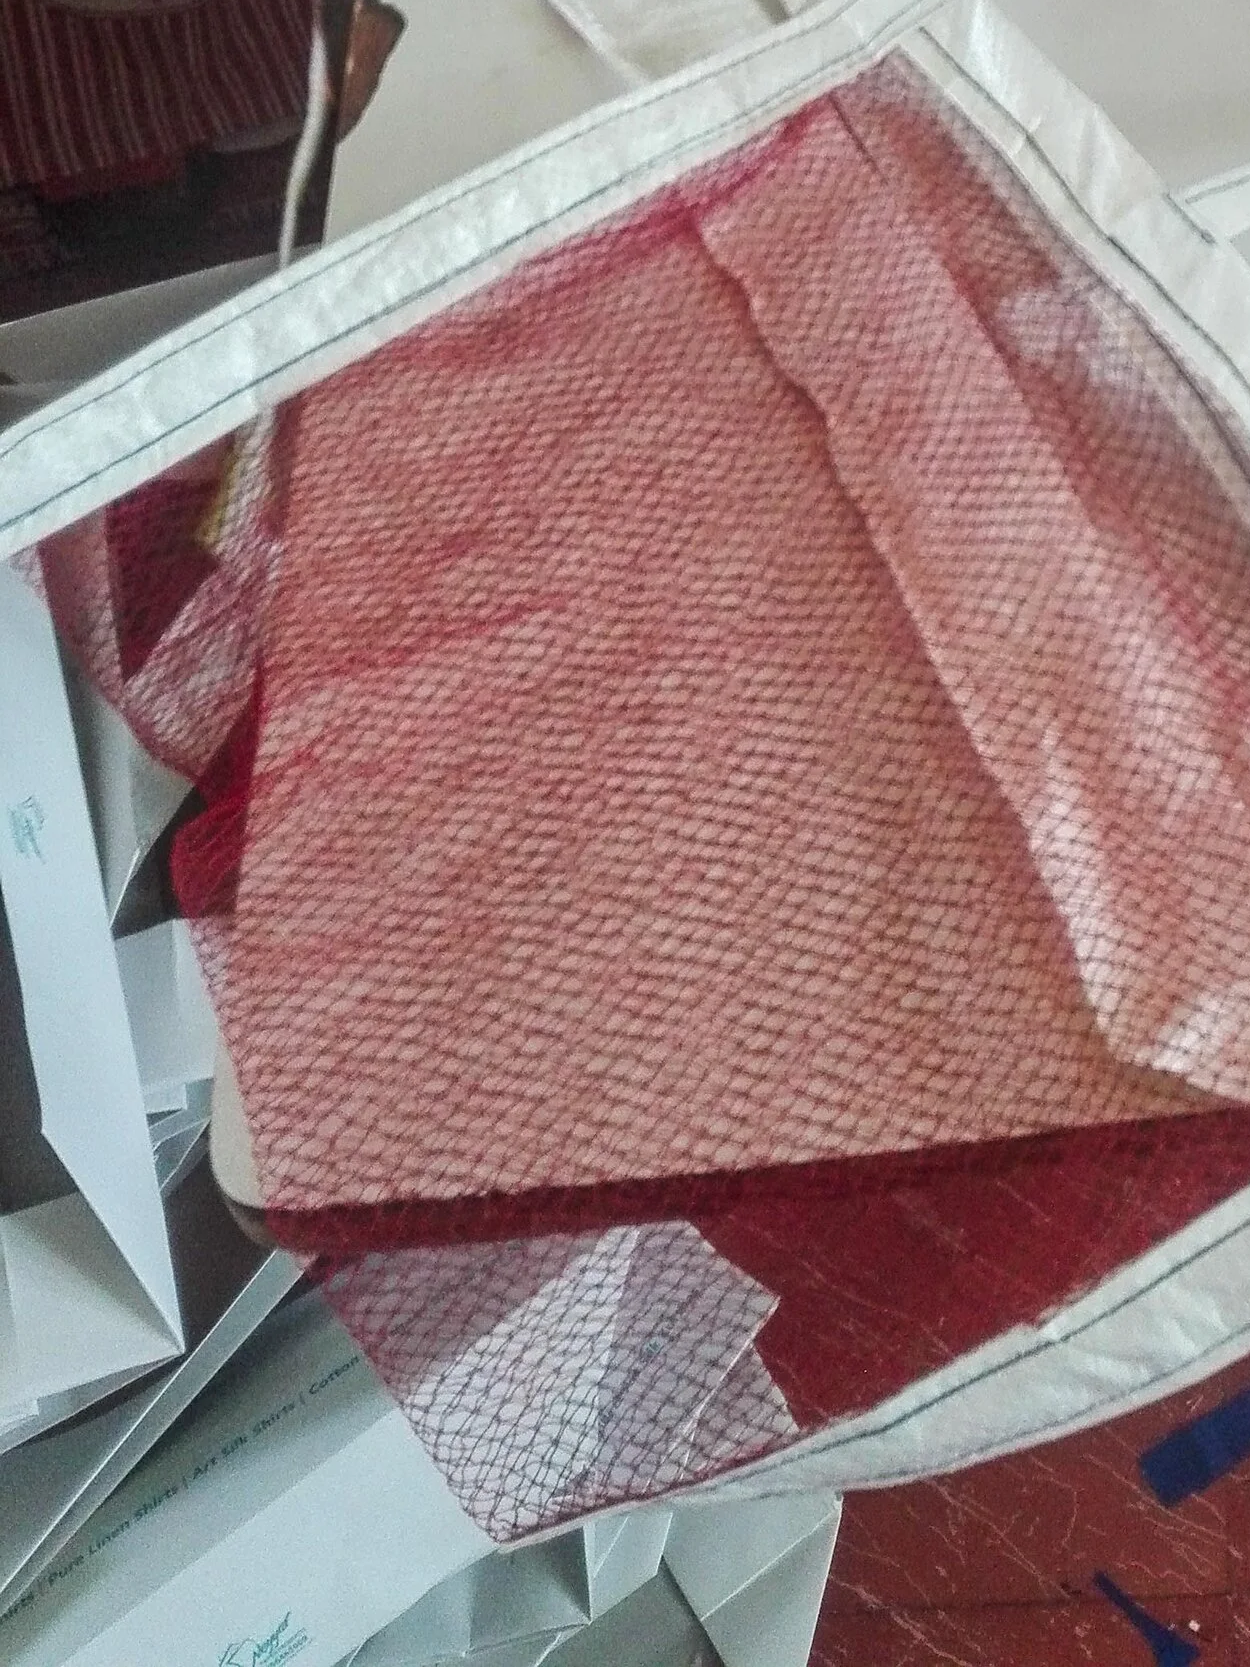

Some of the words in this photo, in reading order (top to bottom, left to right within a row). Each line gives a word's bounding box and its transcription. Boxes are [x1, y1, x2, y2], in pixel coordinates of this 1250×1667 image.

[49, 1554, 85, 1585] Pure
[88, 1520, 130, 1556] Linen
[192, 1455, 218, 1480] Art
[308, 1355, 360, 1395] Cotton
